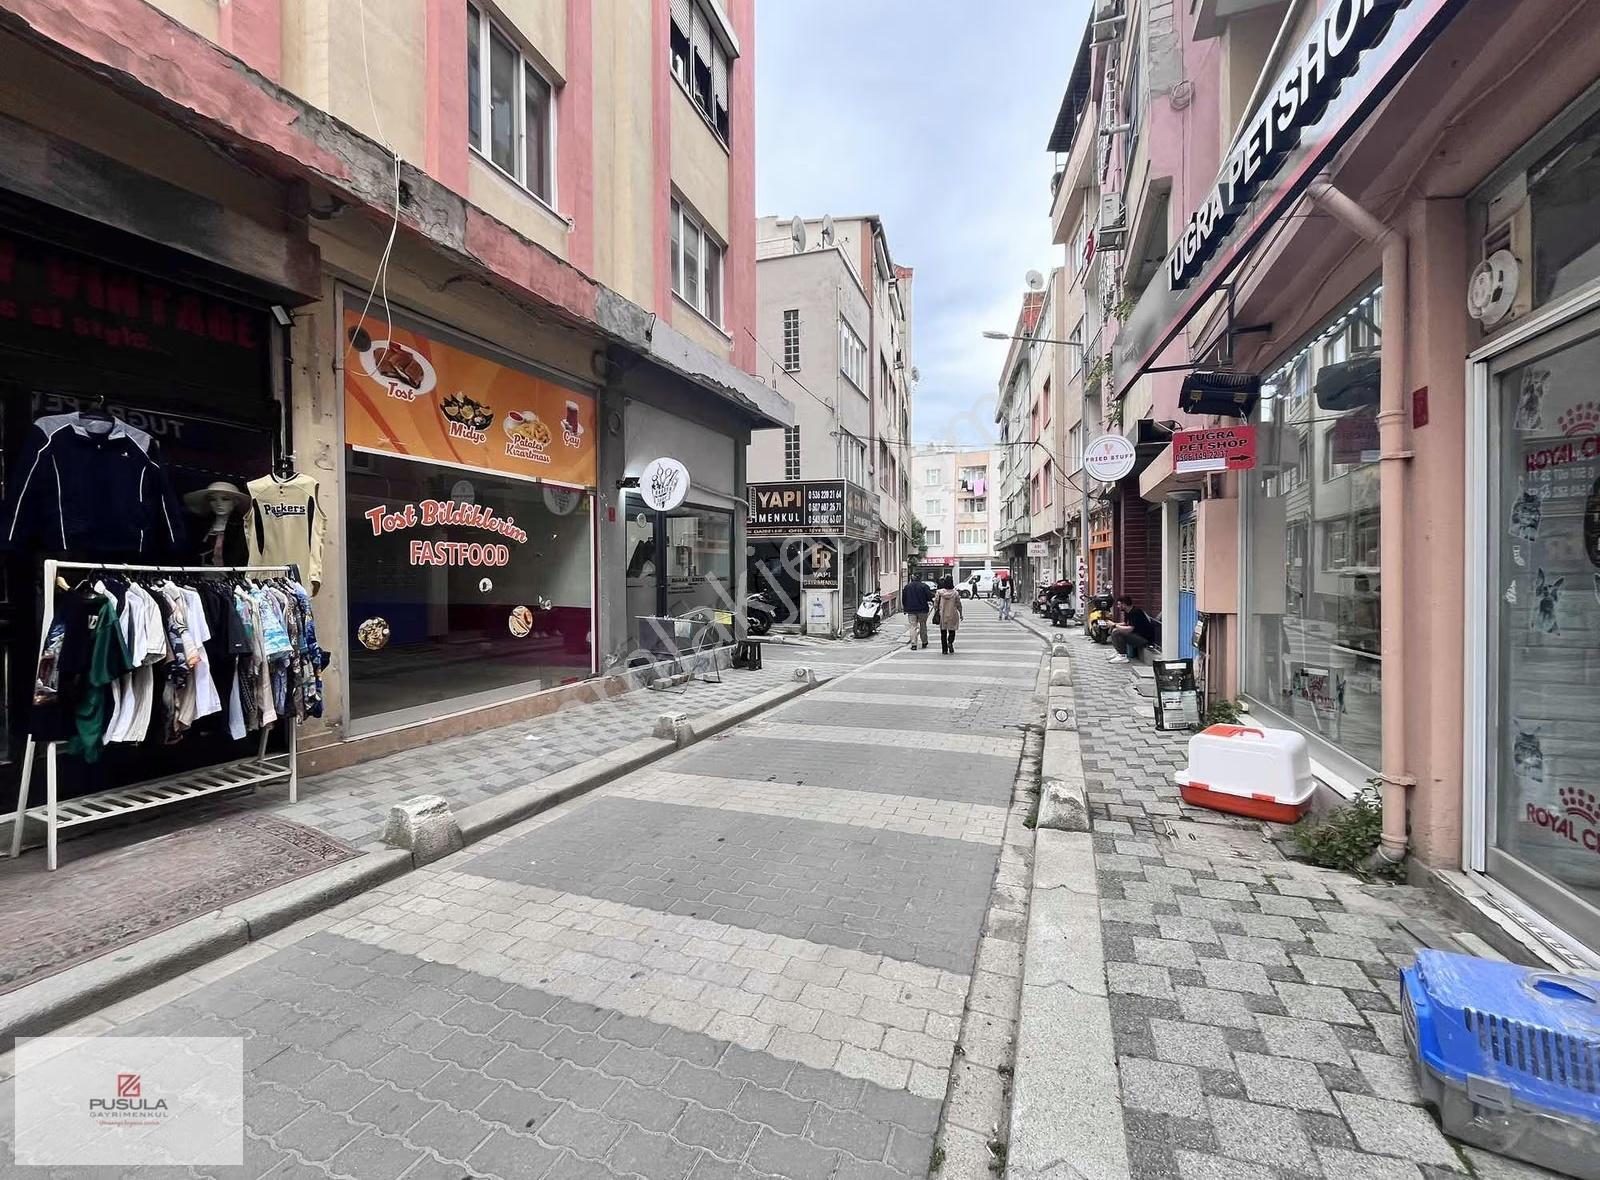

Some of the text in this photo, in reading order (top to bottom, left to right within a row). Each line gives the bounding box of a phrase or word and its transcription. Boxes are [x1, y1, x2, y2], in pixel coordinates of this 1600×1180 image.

[387, 381, 416, 401] Tost
[450, 421, 486, 443] Midye
[563, 431, 581, 448] Çay
[506, 444, 550, 463] Kızartması
[513, 435, 544, 451] Patates
[1526, 437, 1600, 472] ROYAL C
[263, 502, 306, 517] Packers
[757, 490, 802, 508] YAPI
[364, 499, 528, 544] Tost Bildiklerim
[409, 540, 510, 567] FASTFOOD
[811, 543, 832, 568] ER
[1526, 803, 1600, 854] ROYAL C
